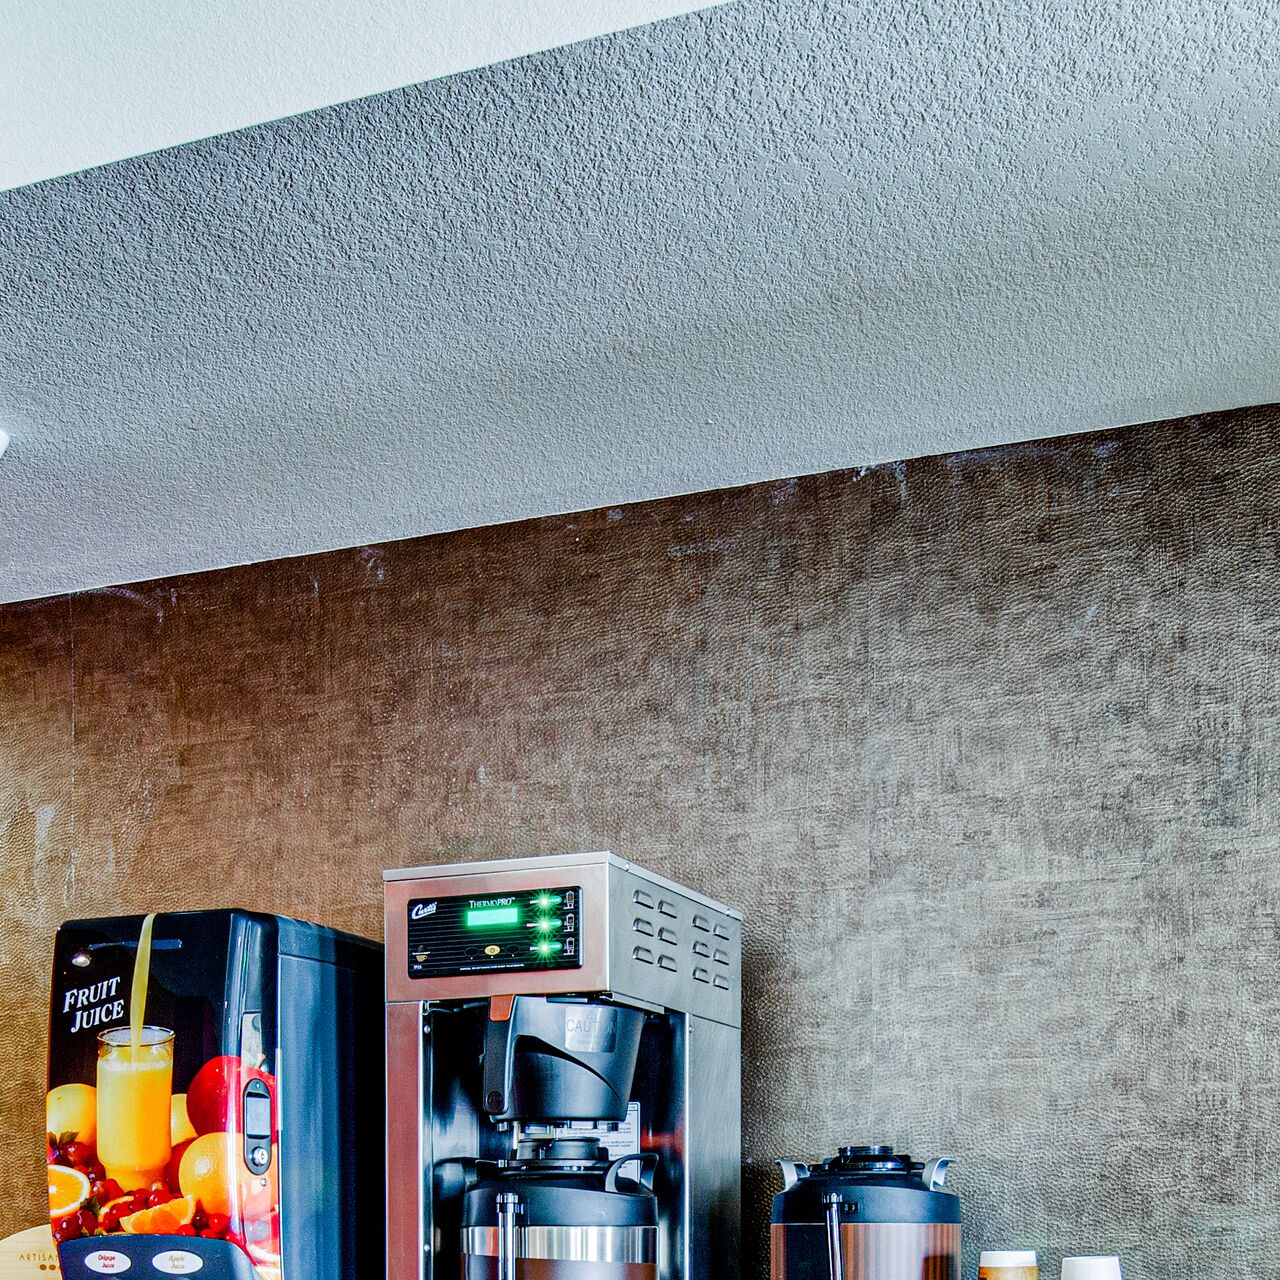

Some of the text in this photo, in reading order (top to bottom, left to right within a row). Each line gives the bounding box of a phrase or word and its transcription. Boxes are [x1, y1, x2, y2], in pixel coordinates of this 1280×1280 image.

[411, 902, 437, 919] Curtis
[63, 976, 121, 1013] FRUIT
[70, 998, 125, 1033] JUICE
